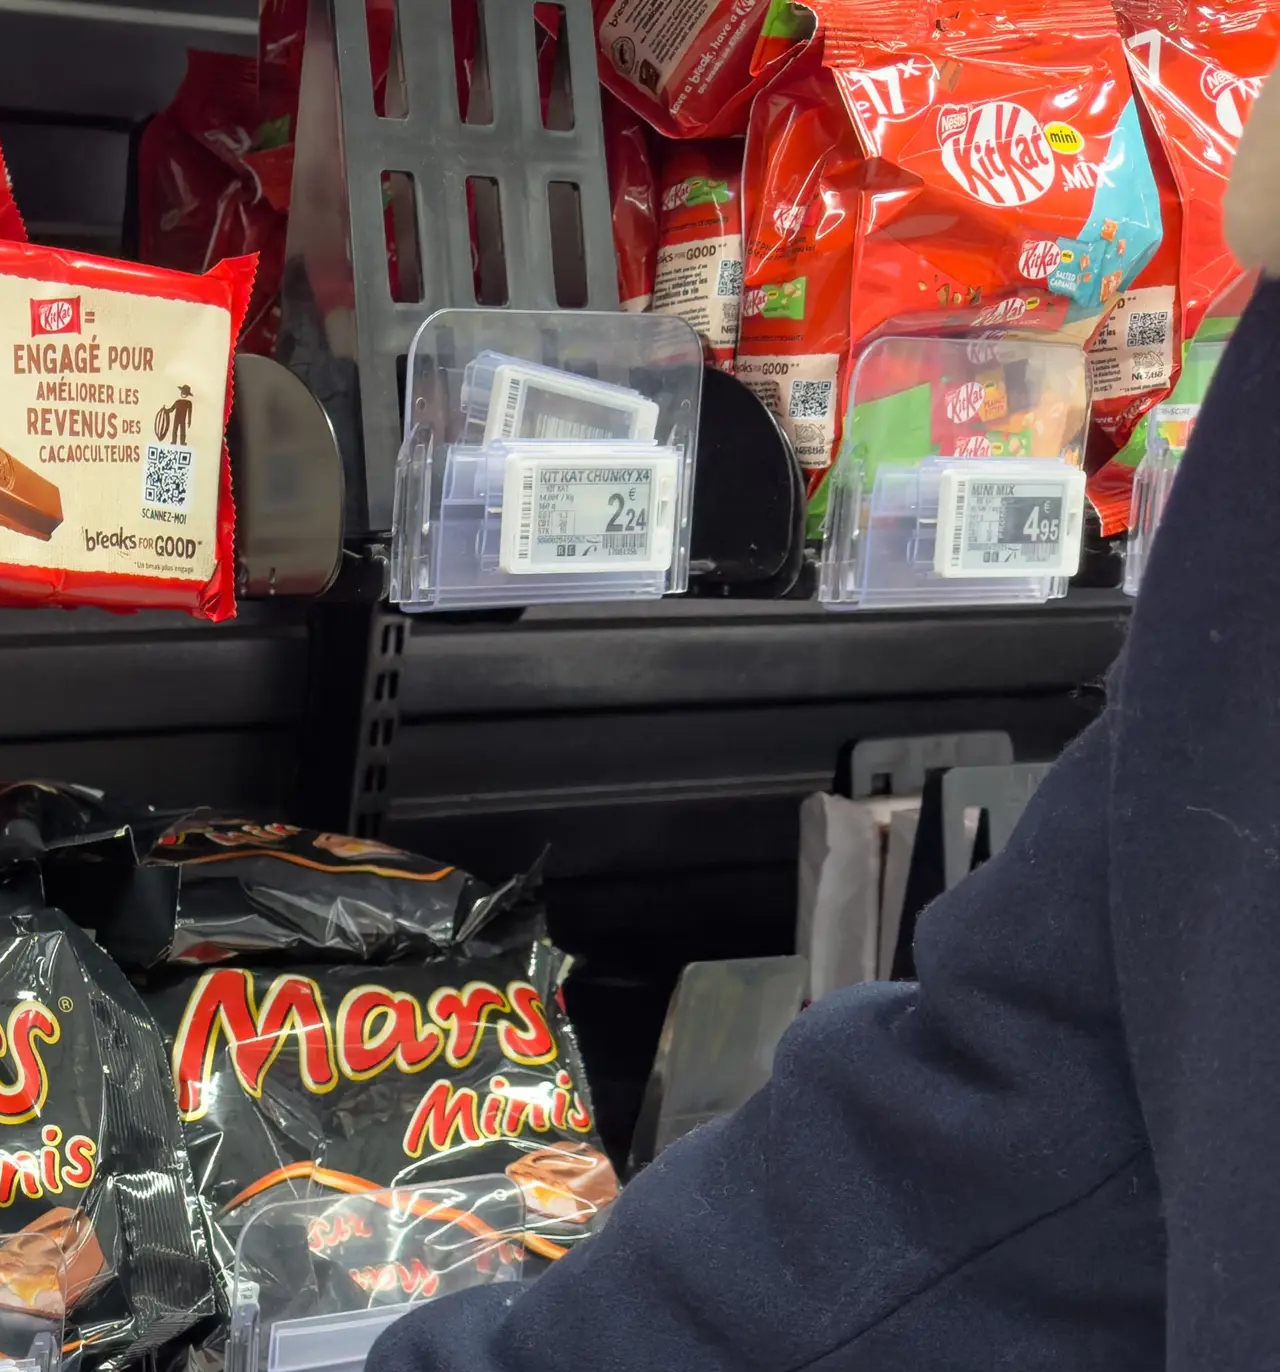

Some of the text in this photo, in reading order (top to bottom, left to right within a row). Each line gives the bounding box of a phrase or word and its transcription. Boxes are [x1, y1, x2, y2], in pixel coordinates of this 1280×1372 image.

[1048, 128, 1079, 146] mini
[953, 101, 1047, 205] KitKat
[1019, 241, 1062, 279] KitKat
[13, 335, 154, 375] ENGAGÉ POUR
[35, 376, 140, 405] AMÉLIORER LES
[947, 383, 986, 424] KitKat
[27, 407, 142, 439] REVENUS DES
[39, 444, 140, 464] CACAOCULTEURS
[540, 468, 650, 483] KIT KAT CHUNKY X4
[970, 484, 1016, 496] MINI MIX
[142, 508, 187, 525] SCANNEZ-MOI
[84, 526, 154, 553] breaks FOR
[172, 967, 560, 1121] Mars
[402, 1075, 593, 1157] Minis
